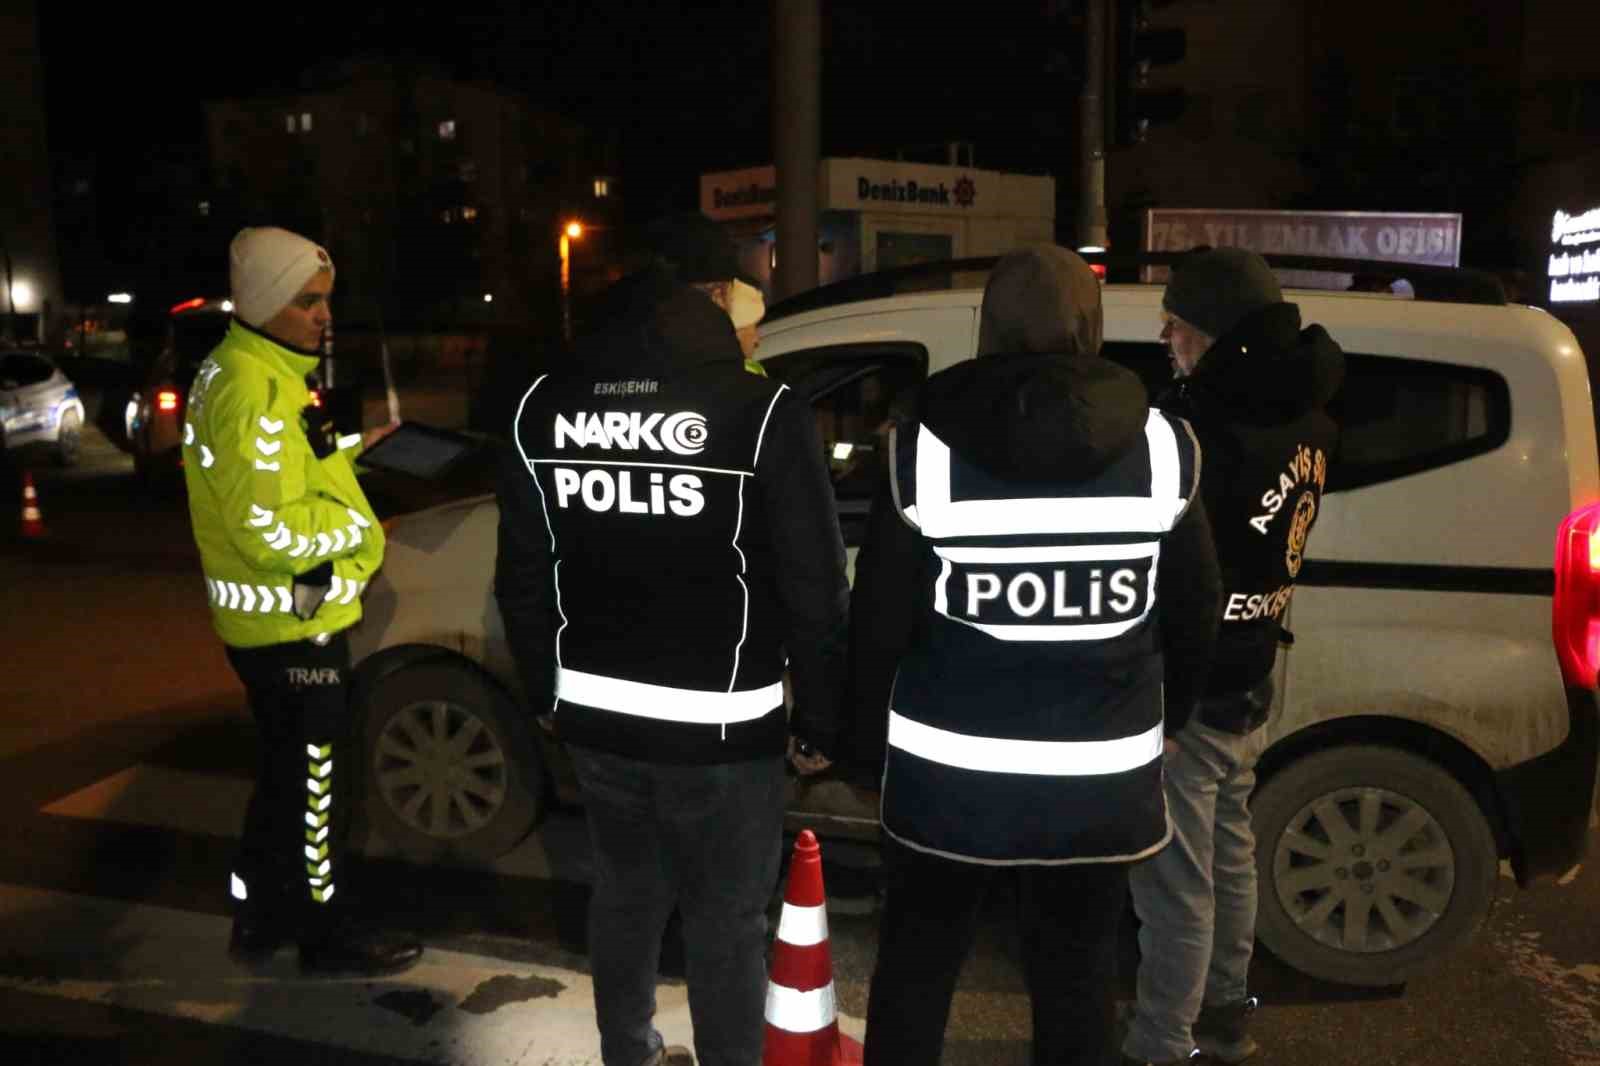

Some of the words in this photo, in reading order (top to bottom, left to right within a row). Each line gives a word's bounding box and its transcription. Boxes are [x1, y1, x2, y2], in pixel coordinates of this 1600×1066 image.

[857, 176, 949, 204] DenizBank
[1260, 222, 1369, 255] EMLAK
[593, 379, 659, 398] ESKİŞEHİR
